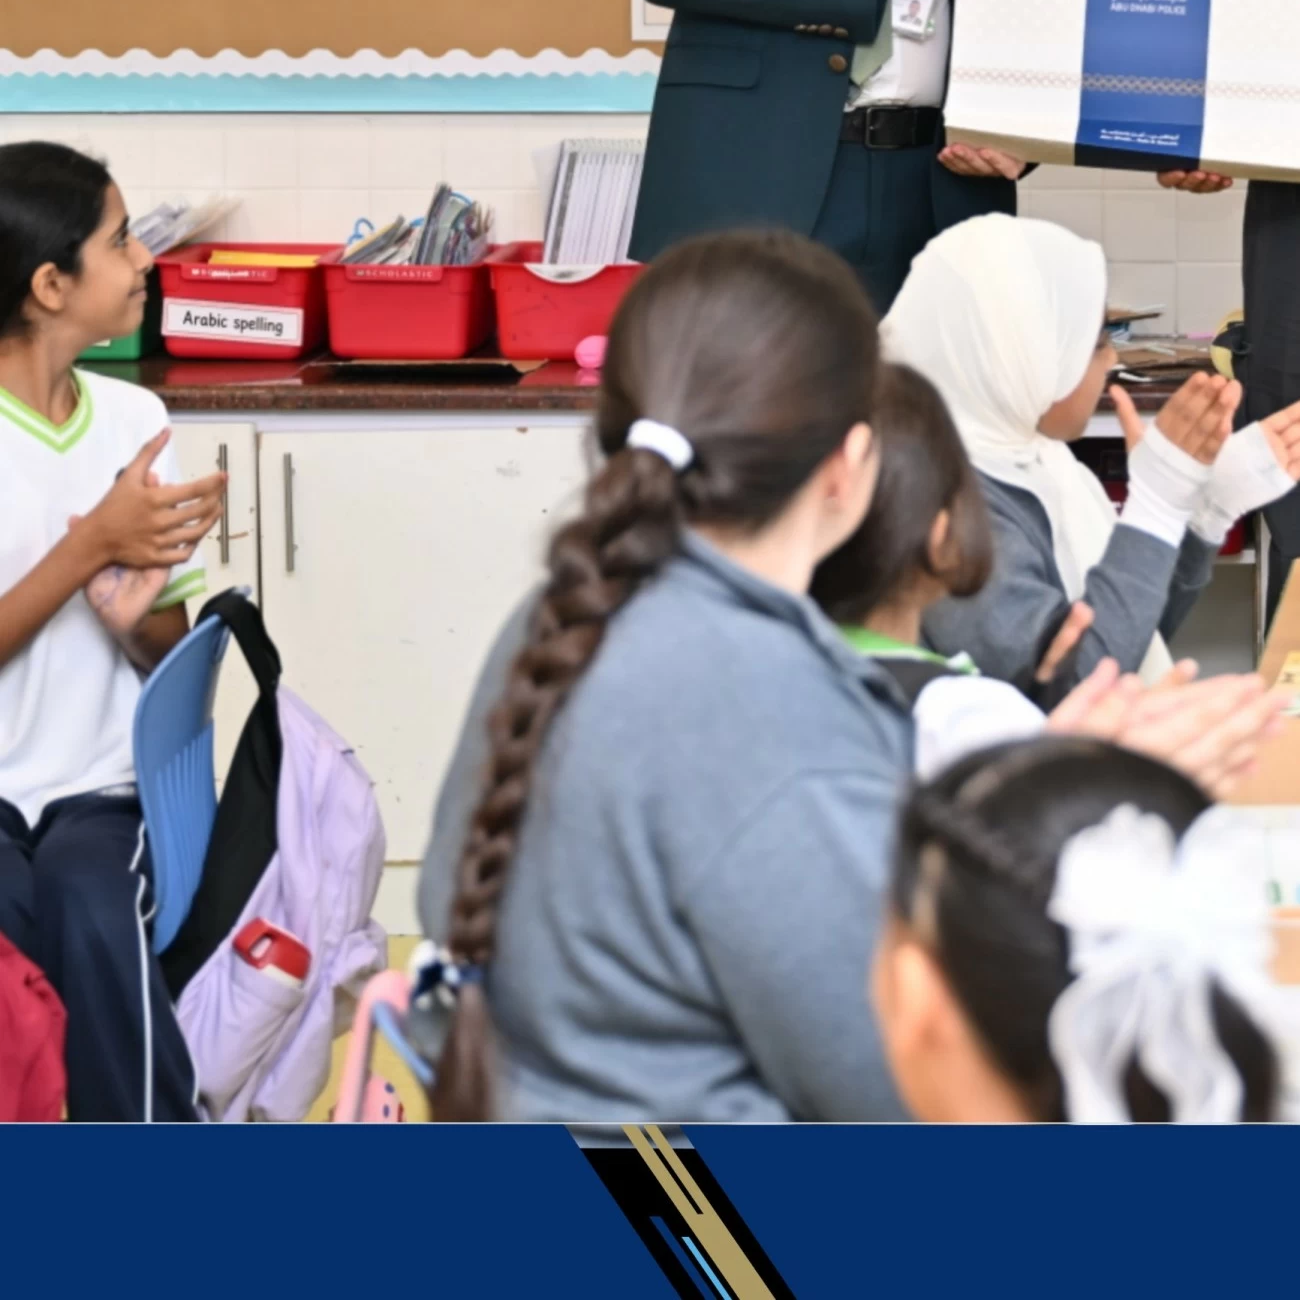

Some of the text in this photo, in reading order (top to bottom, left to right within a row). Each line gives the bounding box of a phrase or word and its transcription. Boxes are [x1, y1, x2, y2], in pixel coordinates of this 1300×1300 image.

[1110, 2, 1129, 12] ABU
[1157, 4, 1187, 16] POLICE
[183, 310, 283, 336] Arabic spelling
